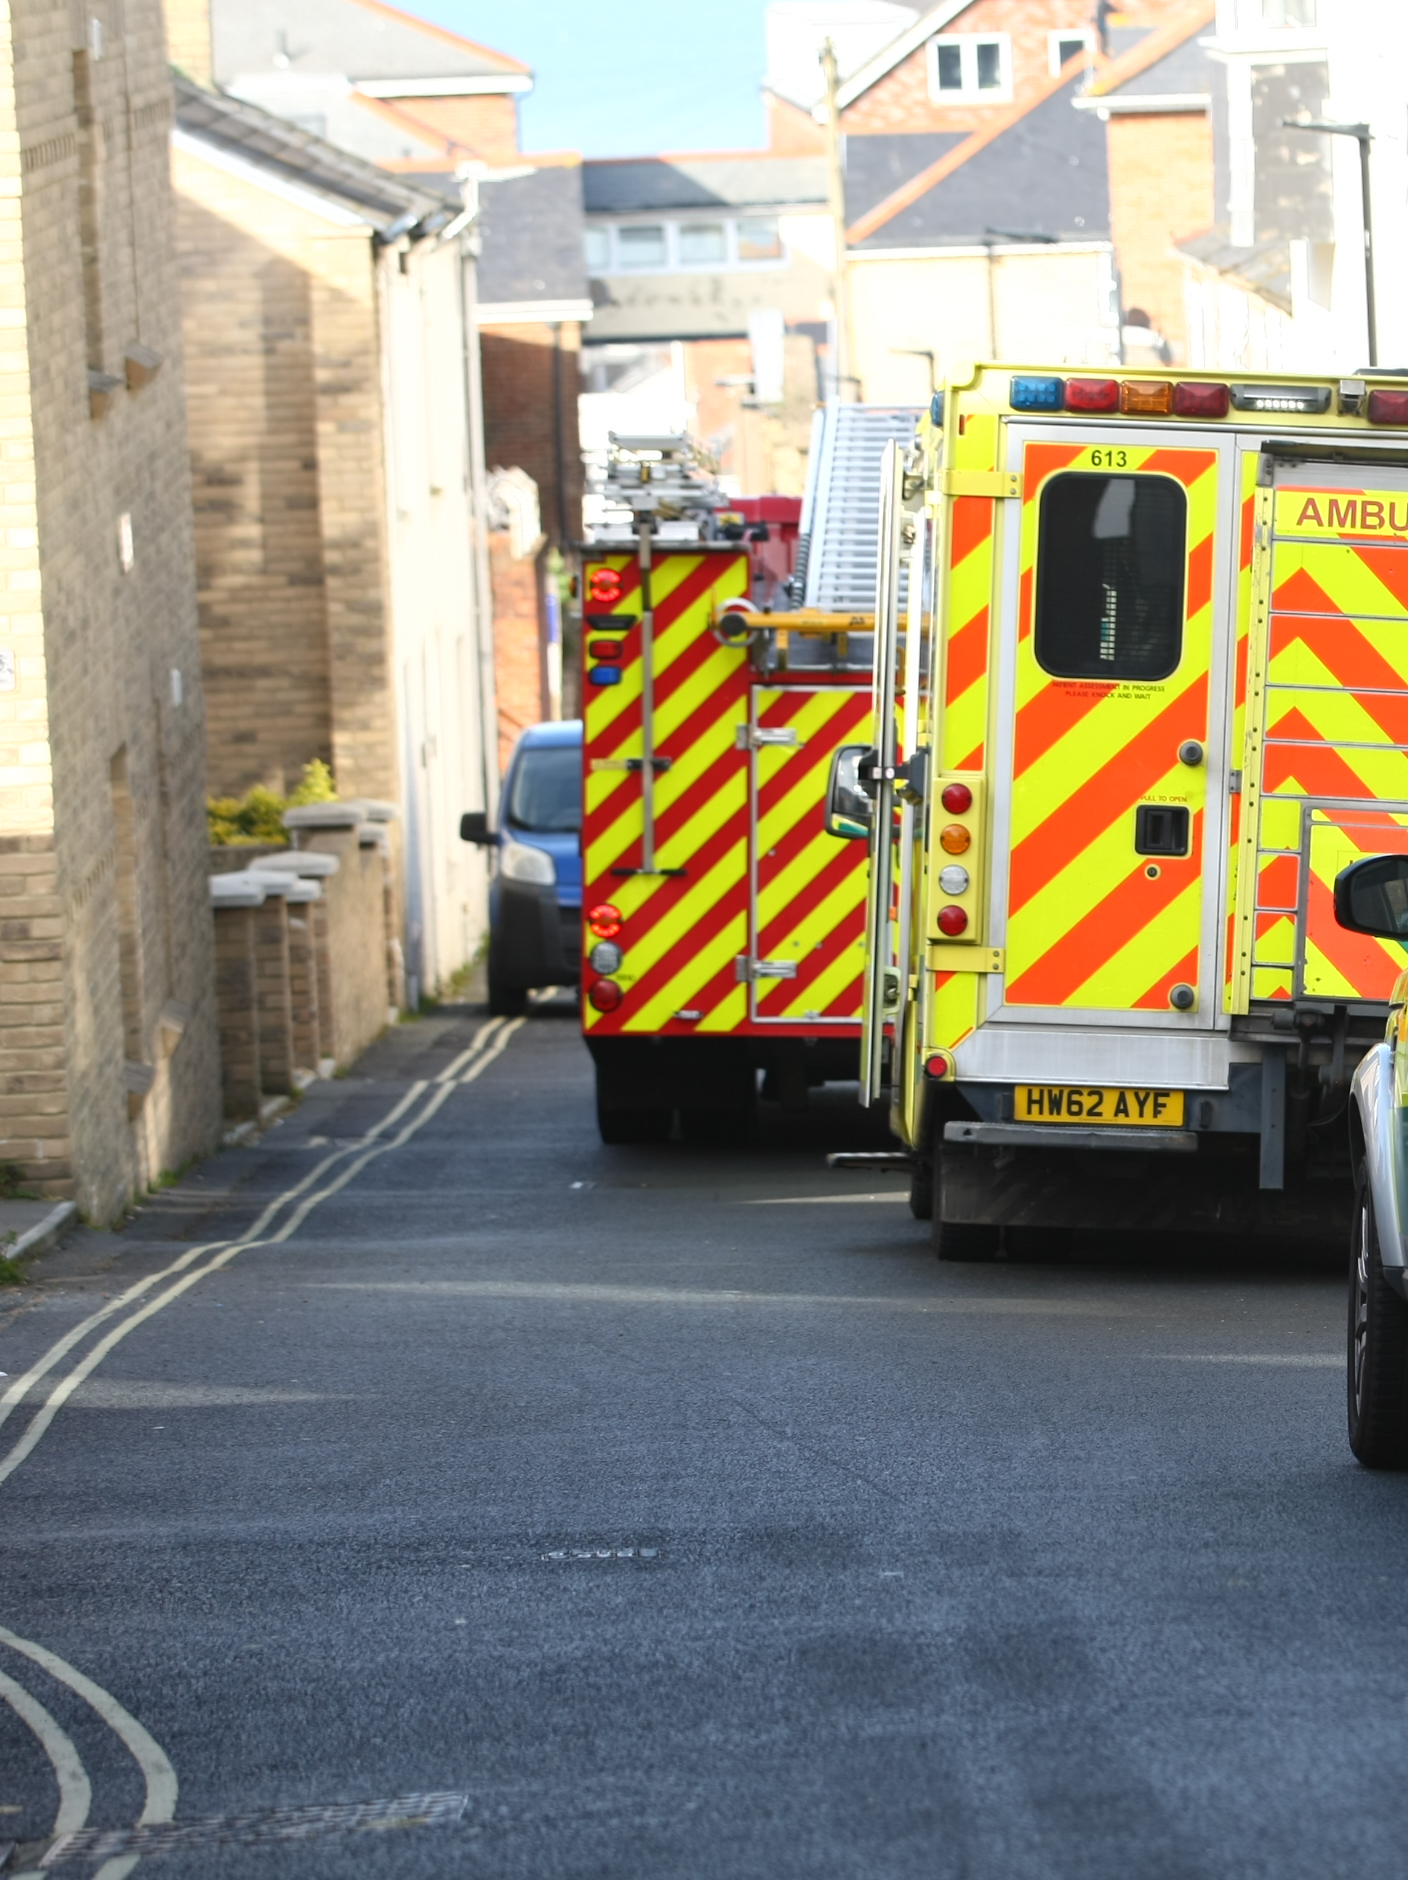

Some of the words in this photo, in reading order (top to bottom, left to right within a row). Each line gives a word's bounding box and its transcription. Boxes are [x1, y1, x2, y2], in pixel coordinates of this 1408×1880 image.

[1091, 450, 1127, 467] 613
[1079, 682, 1121, 690] ASSESSMENT
[1065, 690, 1089, 698] PLEASE
[1091, 691, 1116, 699] KNOCK
[1027, 1088, 1104, 1117] HW62
[1113, 1090, 1170, 1119] AYF
